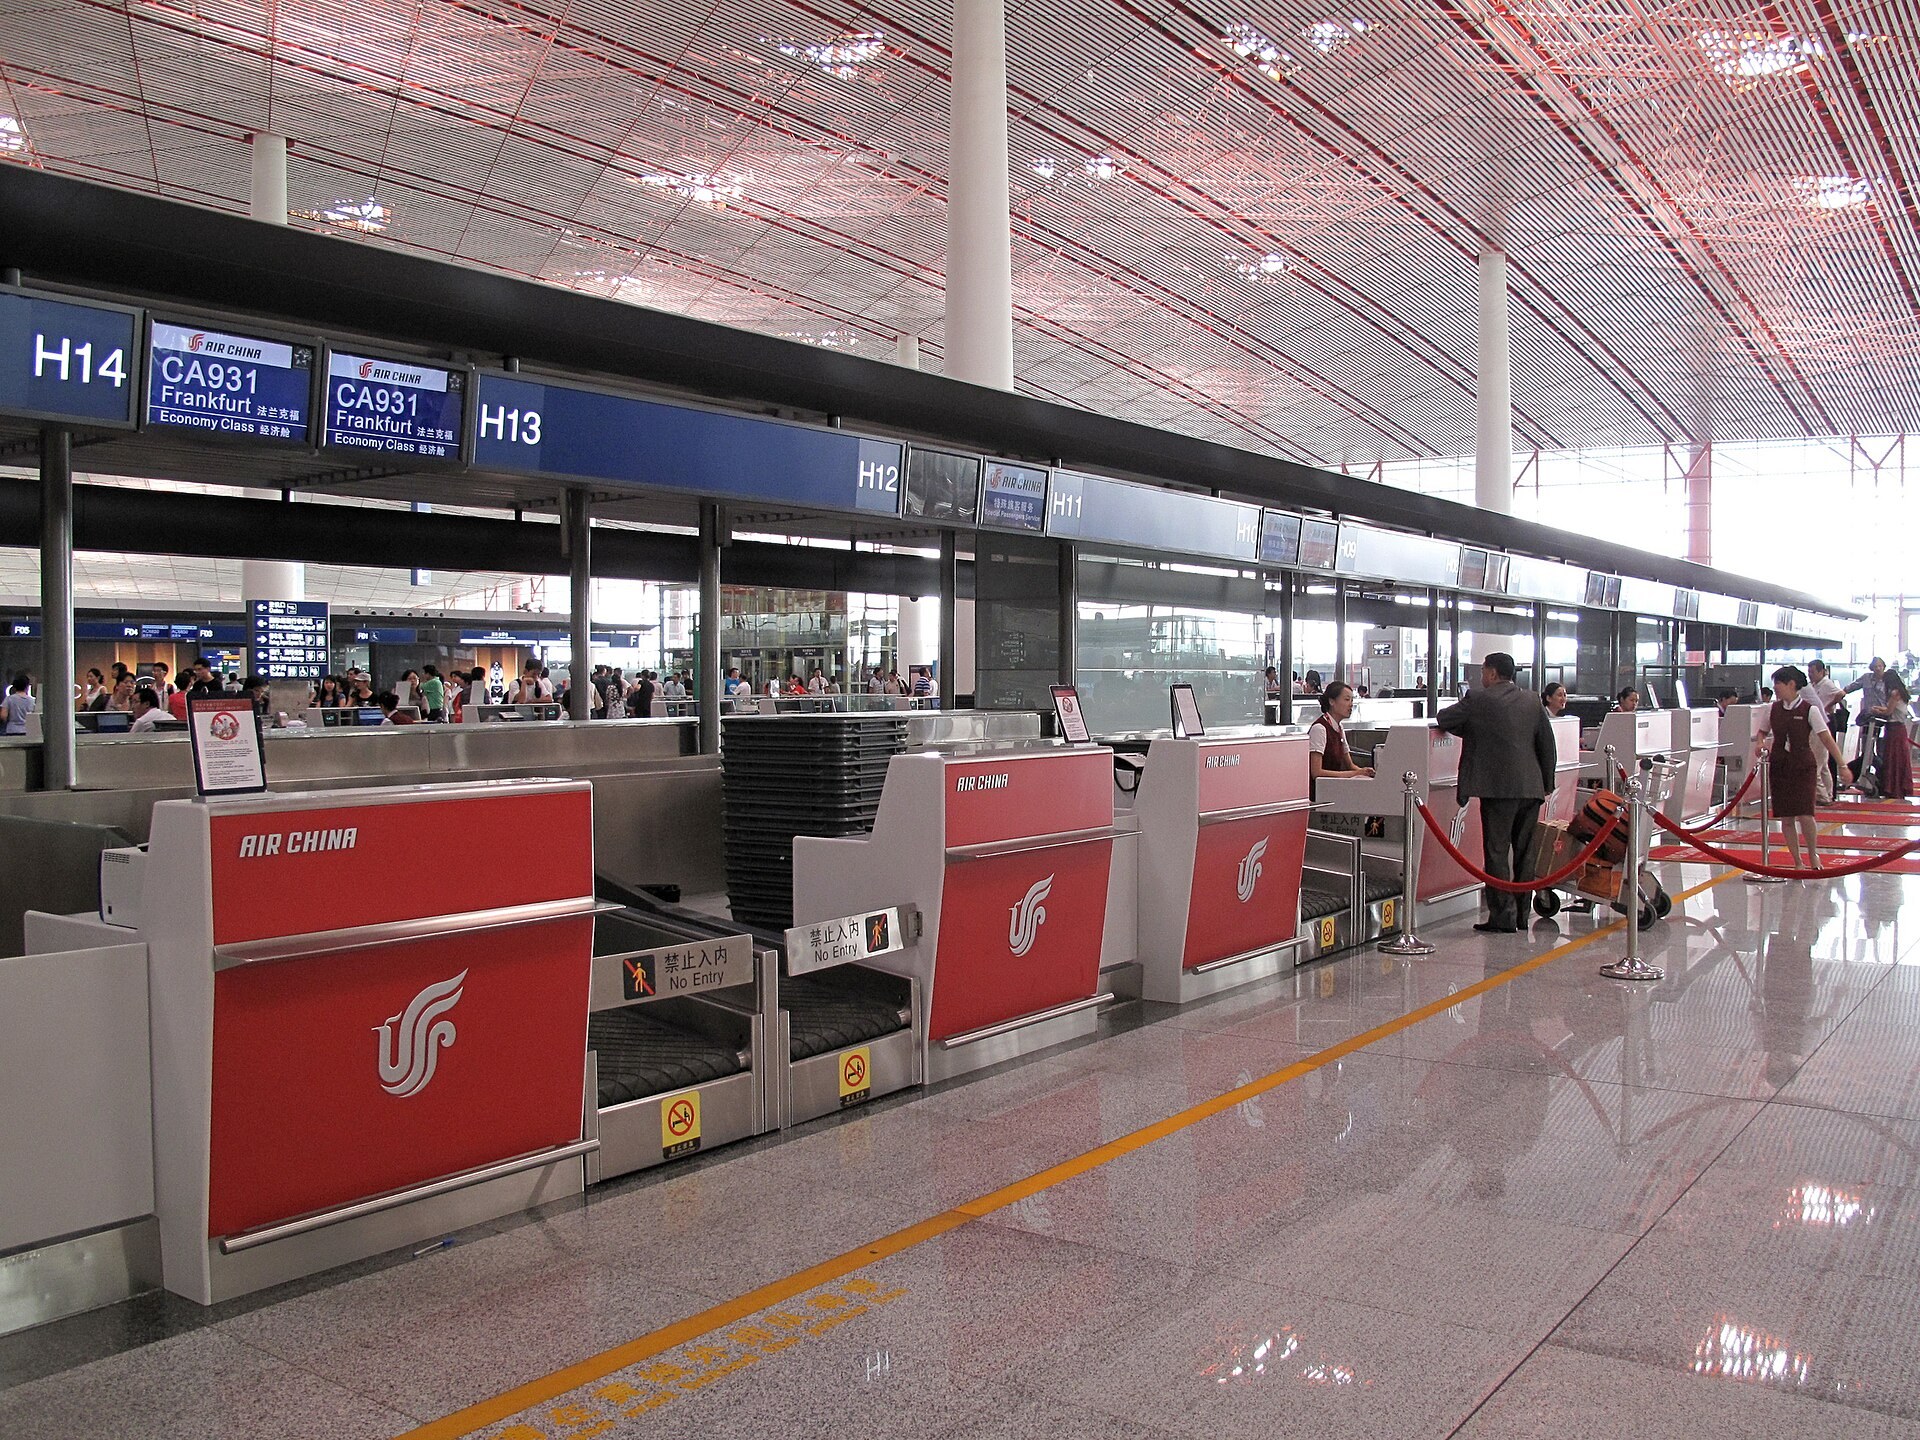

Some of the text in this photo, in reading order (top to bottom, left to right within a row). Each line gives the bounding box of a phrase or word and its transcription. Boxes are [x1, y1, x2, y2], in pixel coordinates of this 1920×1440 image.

[35, 333, 127, 388] H14
[206, 341, 262, 359] AIR CHINA
[162, 356, 258, 394] CA931
[373, 368, 422, 385] AIR CHINA
[161, 385, 252, 414] Frankfurt
[337, 383, 418, 417] CA931
[160, 411, 255, 433] Economy Class
[257, 405, 300, 421] 法兰克福
[336, 409, 413, 435] Frankfurt
[259, 424, 291, 438] 经济舱
[416, 426, 454, 441] 法兰克福
[480, 403, 542, 445] H13
[335, 432, 415, 452] Economy Class
[418, 444, 446, 457] 经济舱
[858, 460, 899, 492] H12
[1001, 476, 1017, 489] AIR
[1052, 492, 1082, 519] H11
[1236, 522, 1258, 545] H10
[124, 627, 139, 637] F04
[1206, 753, 1241, 768] AIR CHINA
[957, 773, 1009, 792] AIR CHINA
[239, 827, 358, 858] AIR CHINA
[810, 920, 859, 947] 禁止入内
[664, 945, 728, 973] 禁止入内
[814, 943, 858, 963] No Entry
[670, 970, 724, 990] No Entry
